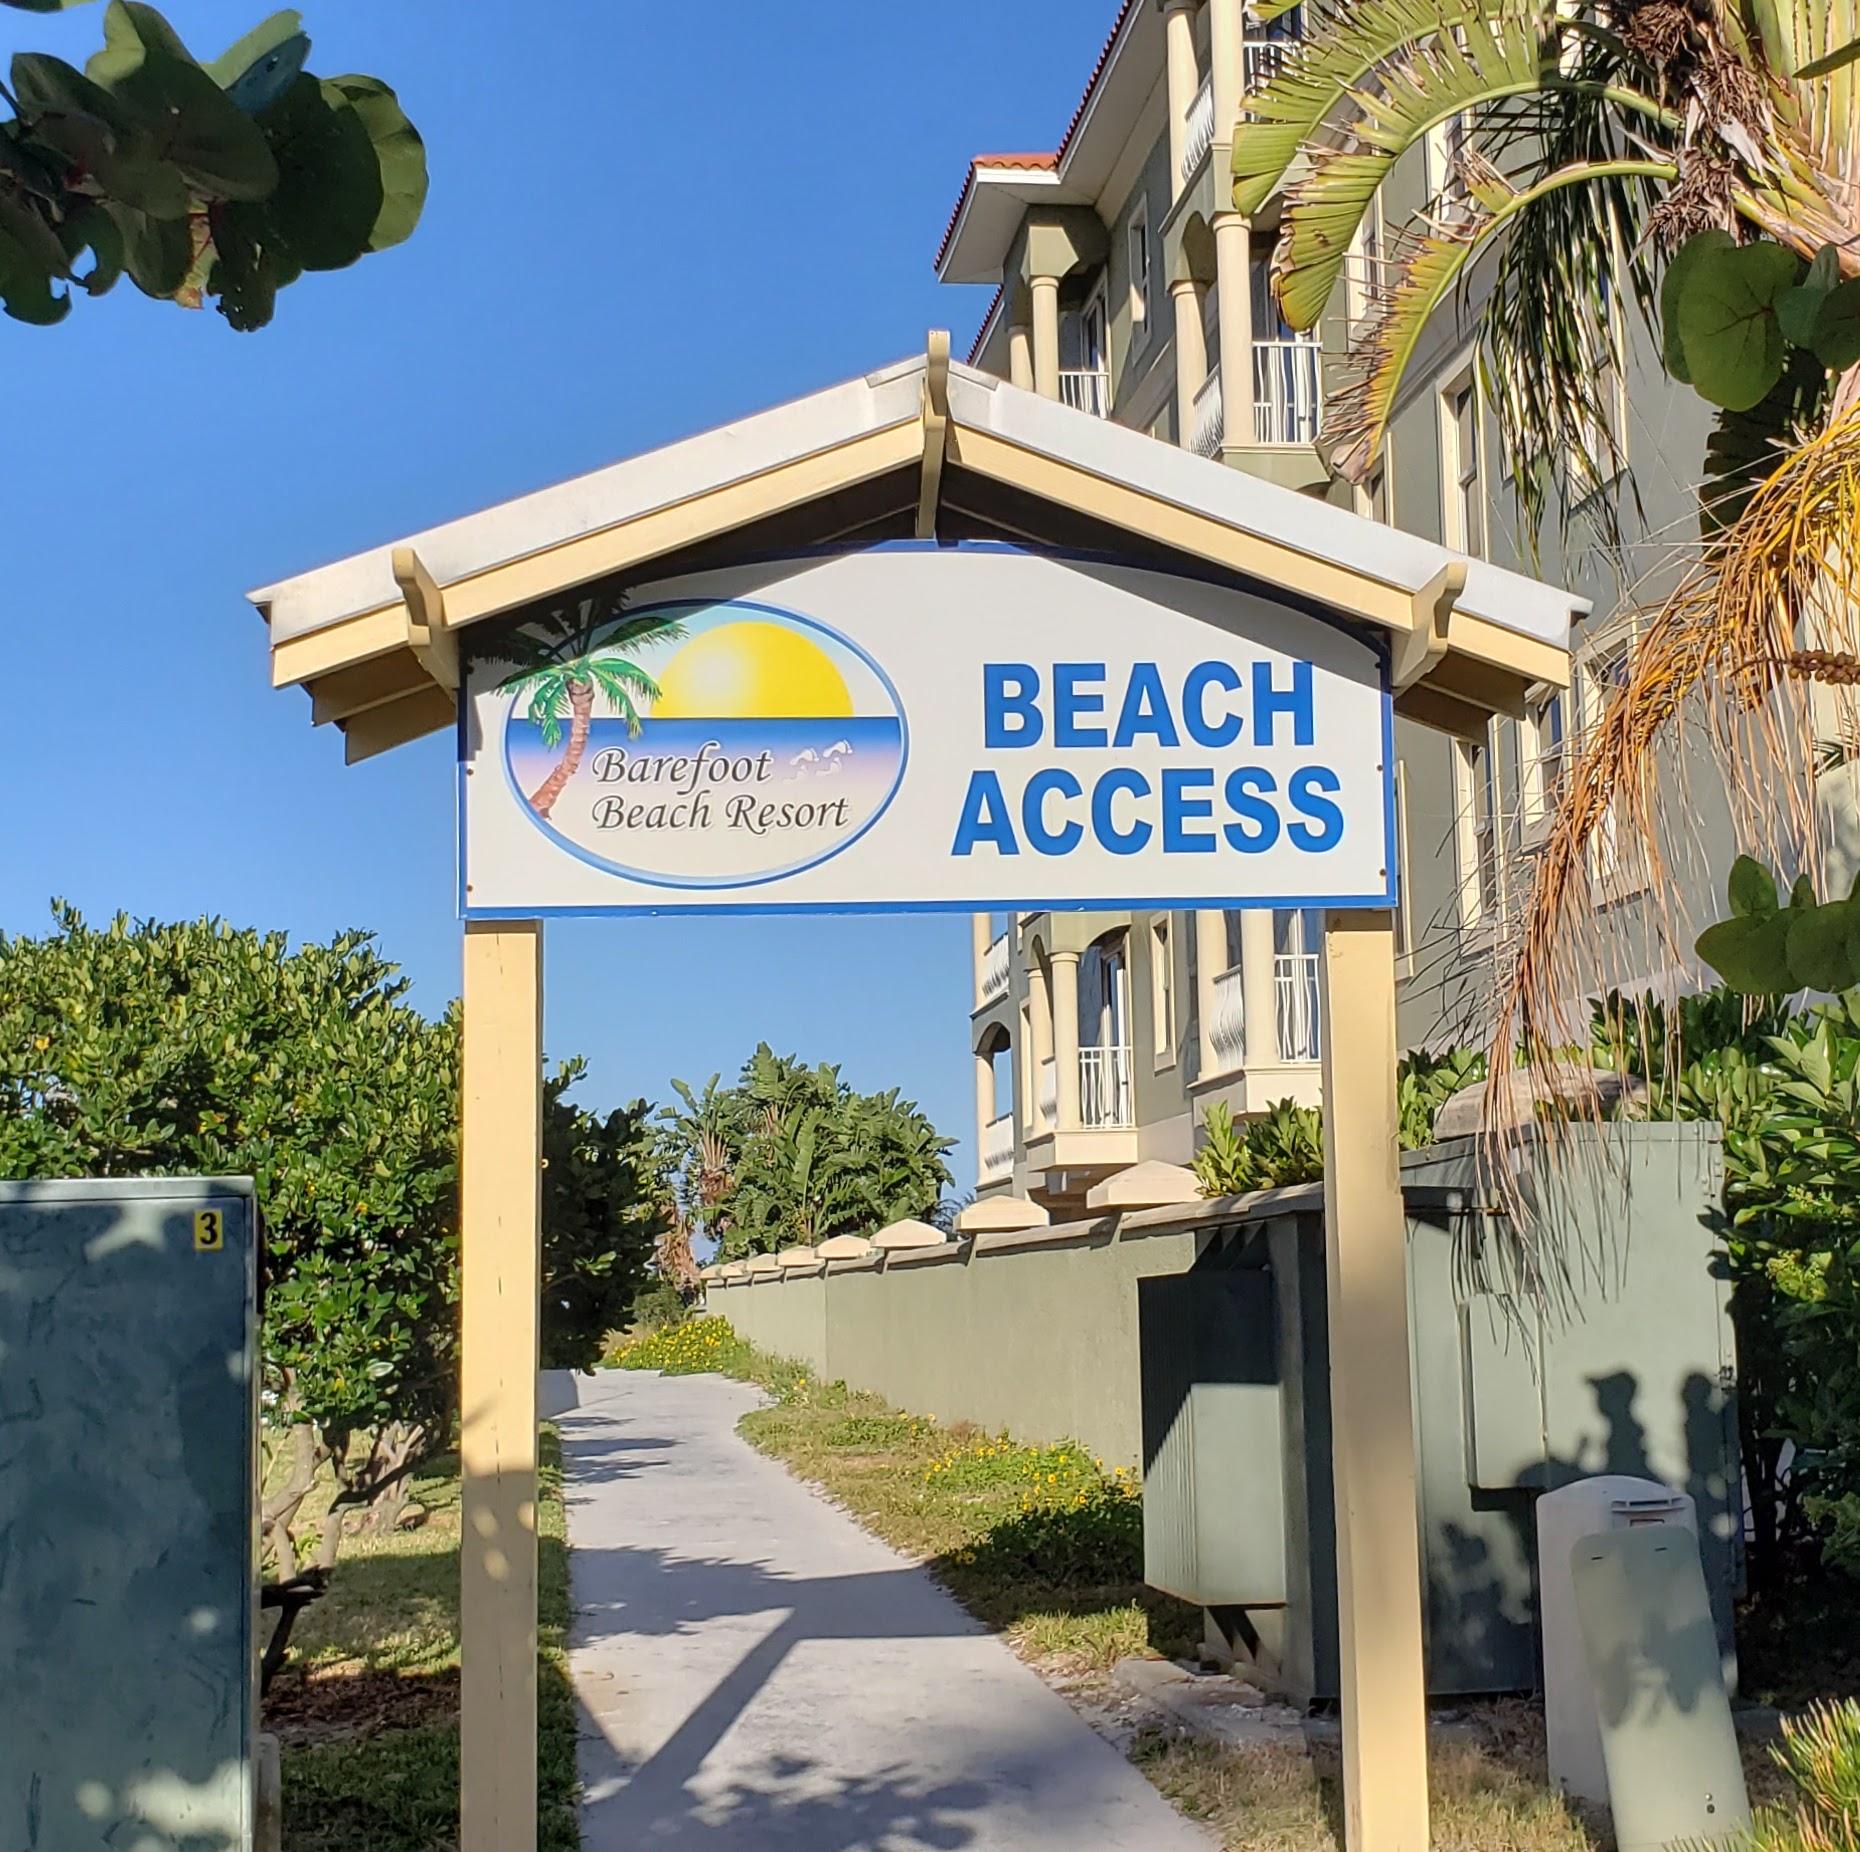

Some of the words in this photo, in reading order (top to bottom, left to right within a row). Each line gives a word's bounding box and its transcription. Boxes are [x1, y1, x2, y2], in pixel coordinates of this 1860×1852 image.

[983, 661, 1315, 749] BEACH
[592, 740, 773, 796] Barefoot
[592, 789, 711, 829] Beach
[725, 794, 849, 835] Resort
[951, 766, 1344, 856] ACCESS
[200, 1211, 218, 1246] 3
